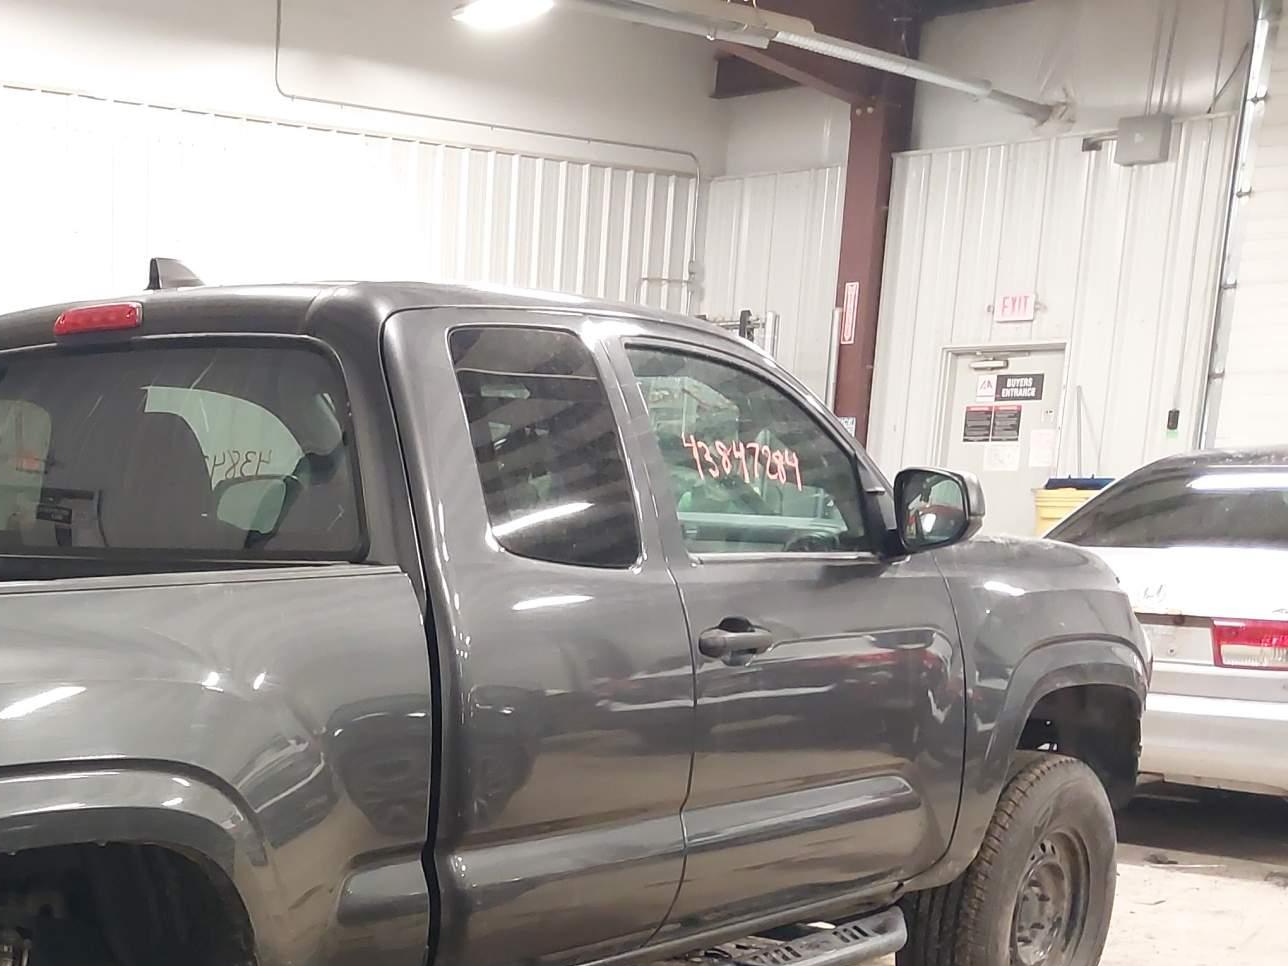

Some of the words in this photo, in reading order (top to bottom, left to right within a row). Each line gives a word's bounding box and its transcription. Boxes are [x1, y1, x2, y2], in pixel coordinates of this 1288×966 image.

[1006, 377, 1034, 388] BUYERS
[1001, 386, 1037, 398] ENTRANCE
[681, 431, 803, 491] 43847284
